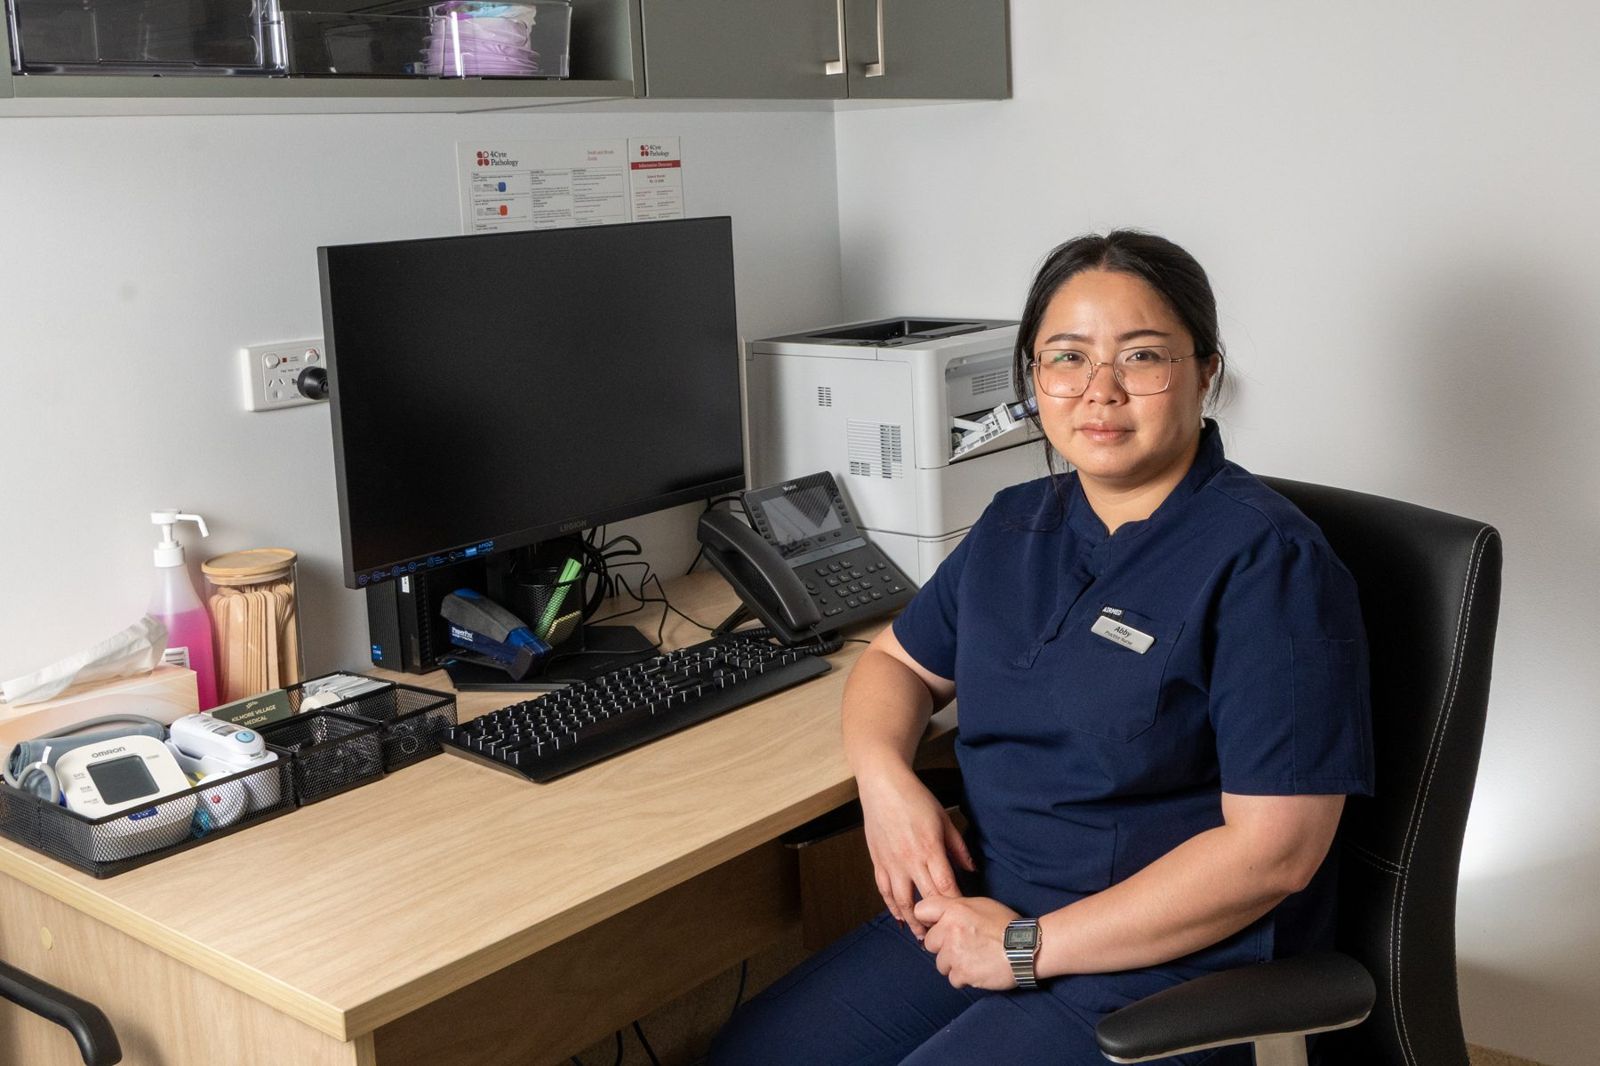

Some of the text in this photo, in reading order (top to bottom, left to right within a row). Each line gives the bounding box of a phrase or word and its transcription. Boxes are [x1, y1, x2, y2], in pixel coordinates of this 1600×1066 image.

[490, 150, 507, 159] 4Cyte
[490, 159, 519, 167] Pathology
[1114, 626, 1132, 637] Abby
[231, 711, 255, 722] KILMORE
[254, 704, 276, 715] VILLAGE
[244, 716, 268, 725] MEDICAL
